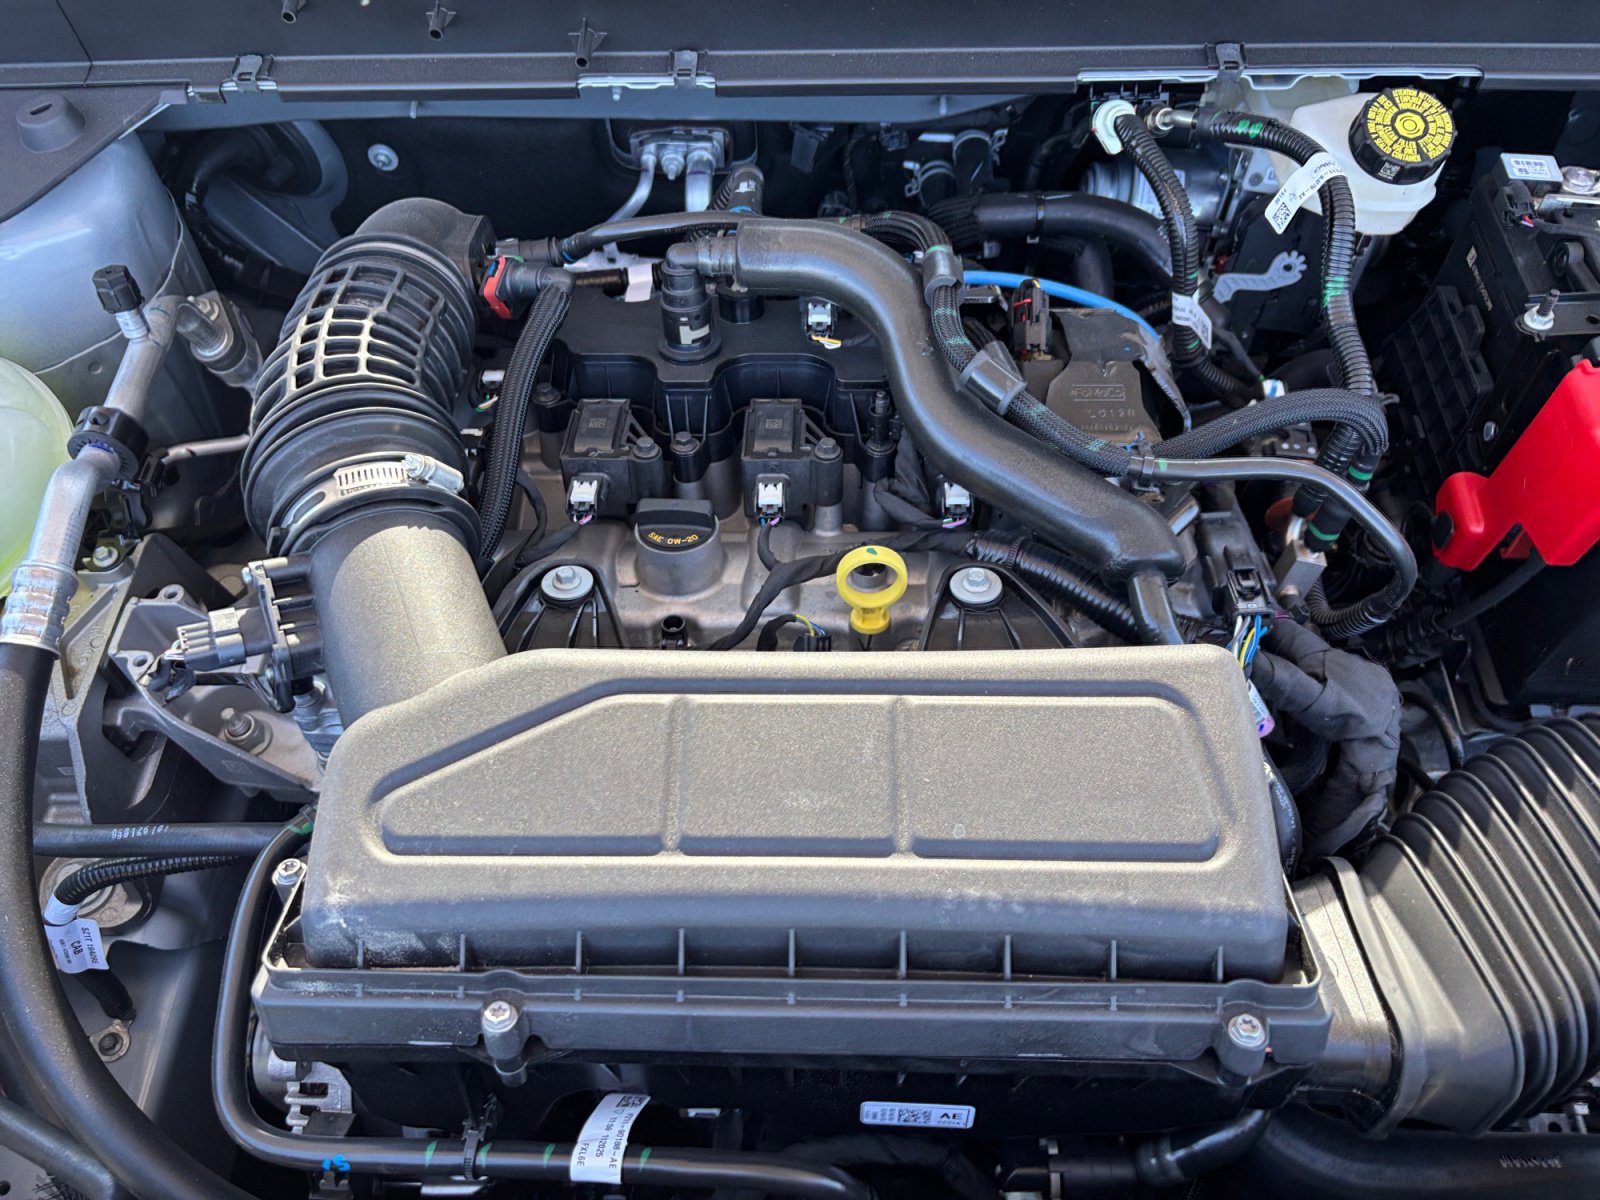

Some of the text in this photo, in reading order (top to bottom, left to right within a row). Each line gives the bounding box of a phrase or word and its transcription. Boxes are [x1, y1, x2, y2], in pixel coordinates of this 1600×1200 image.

[1368, 120, 1377, 133] FROM
[1374, 138, 1392, 154] SEALED
[1392, 151, 1421, 162] CONTAINER
[648, 532, 699, 545] SAE 0W-20
[71, 940, 83, 955] CAB
[940, 1112, 964, 1120] AE
[577, 1142, 590, 1167] FXL6E
